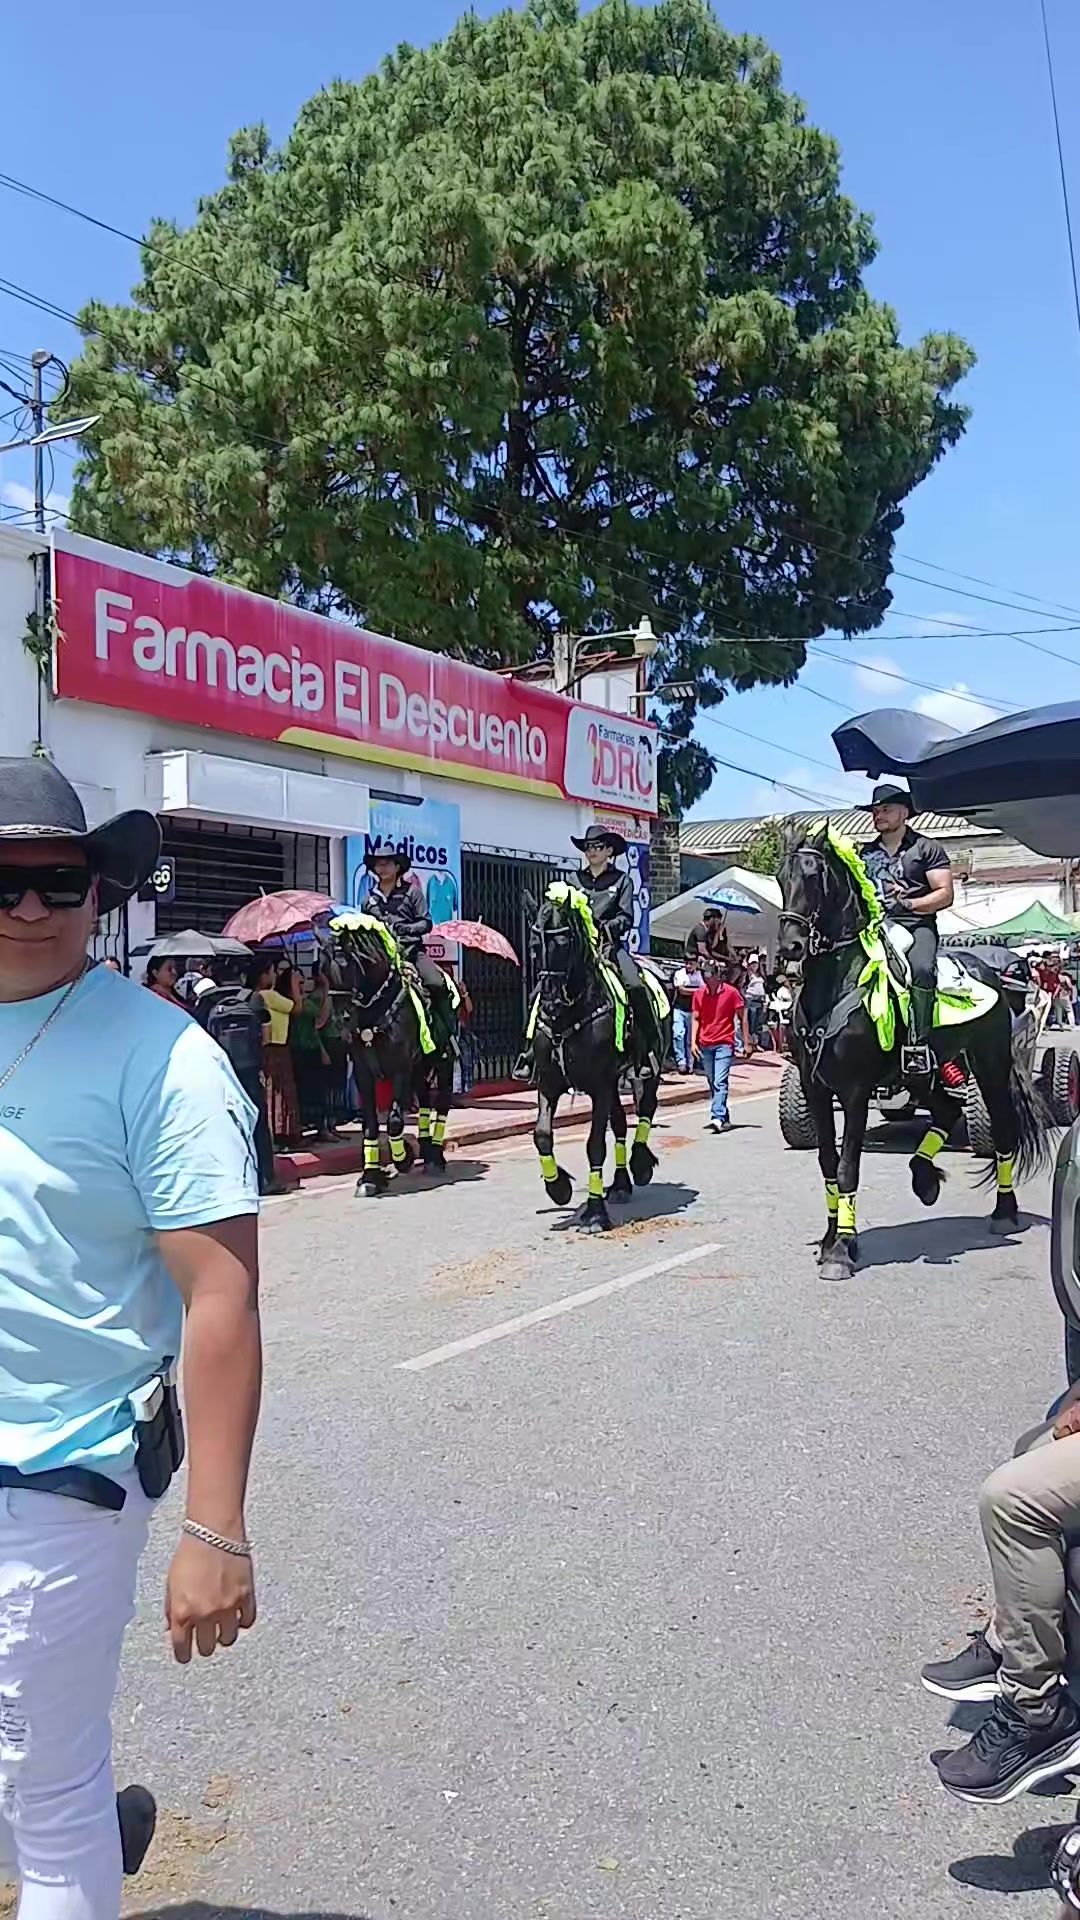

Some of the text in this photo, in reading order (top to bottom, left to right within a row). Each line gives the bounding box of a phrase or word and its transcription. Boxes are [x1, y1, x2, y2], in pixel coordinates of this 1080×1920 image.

[95, 588, 547, 765] Farmacia El Descuento
[364, 834, 448, 865] Médicos
